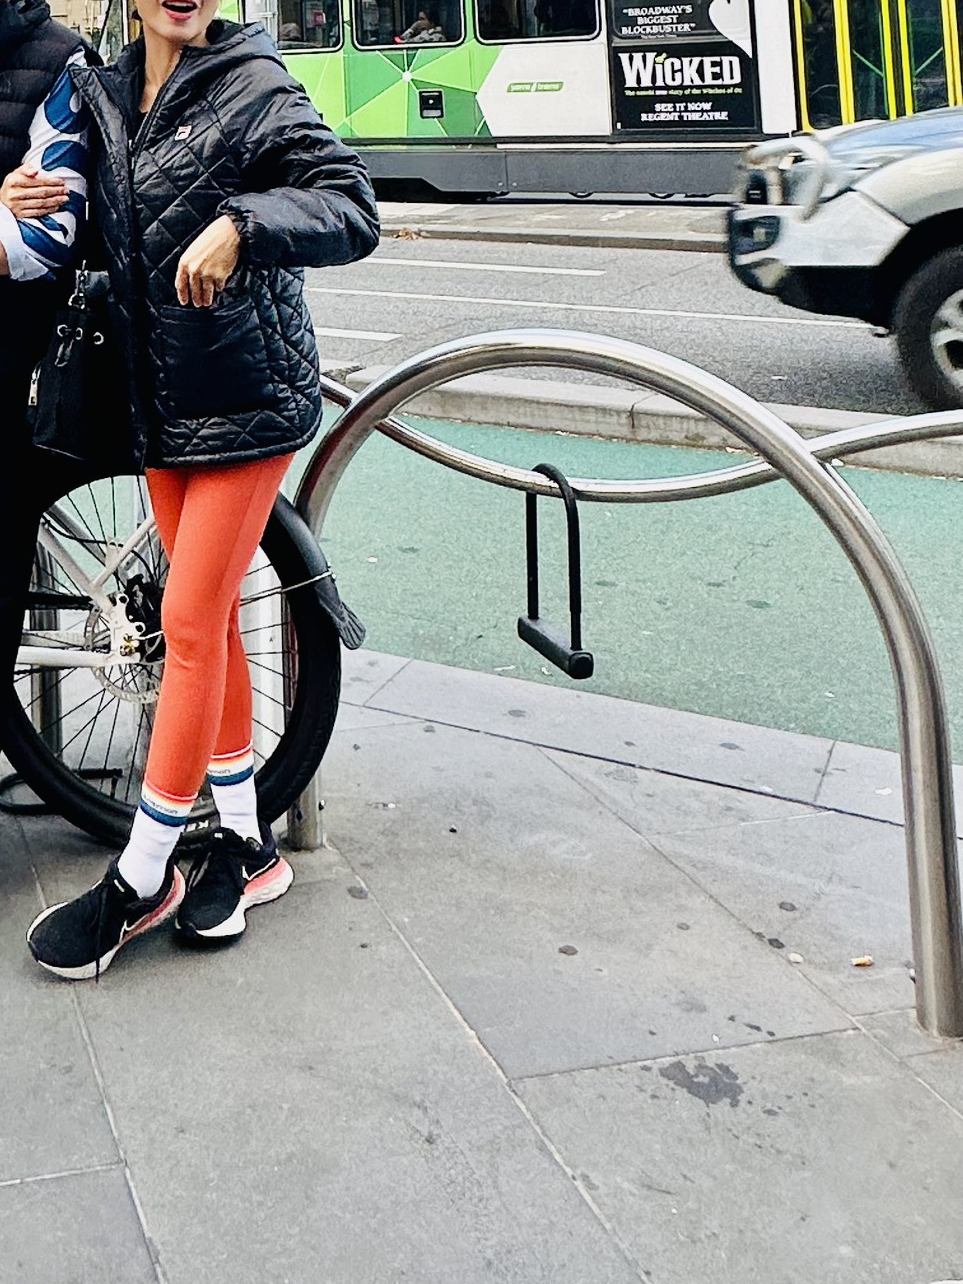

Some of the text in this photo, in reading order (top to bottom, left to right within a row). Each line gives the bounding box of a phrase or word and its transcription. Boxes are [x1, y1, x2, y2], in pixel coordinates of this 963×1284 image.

[637, 15, 679, 25] BIGGEST
[654, 102, 712, 112] SEE IT NOW
[640, 111, 729, 122] REGENT THEATRE
